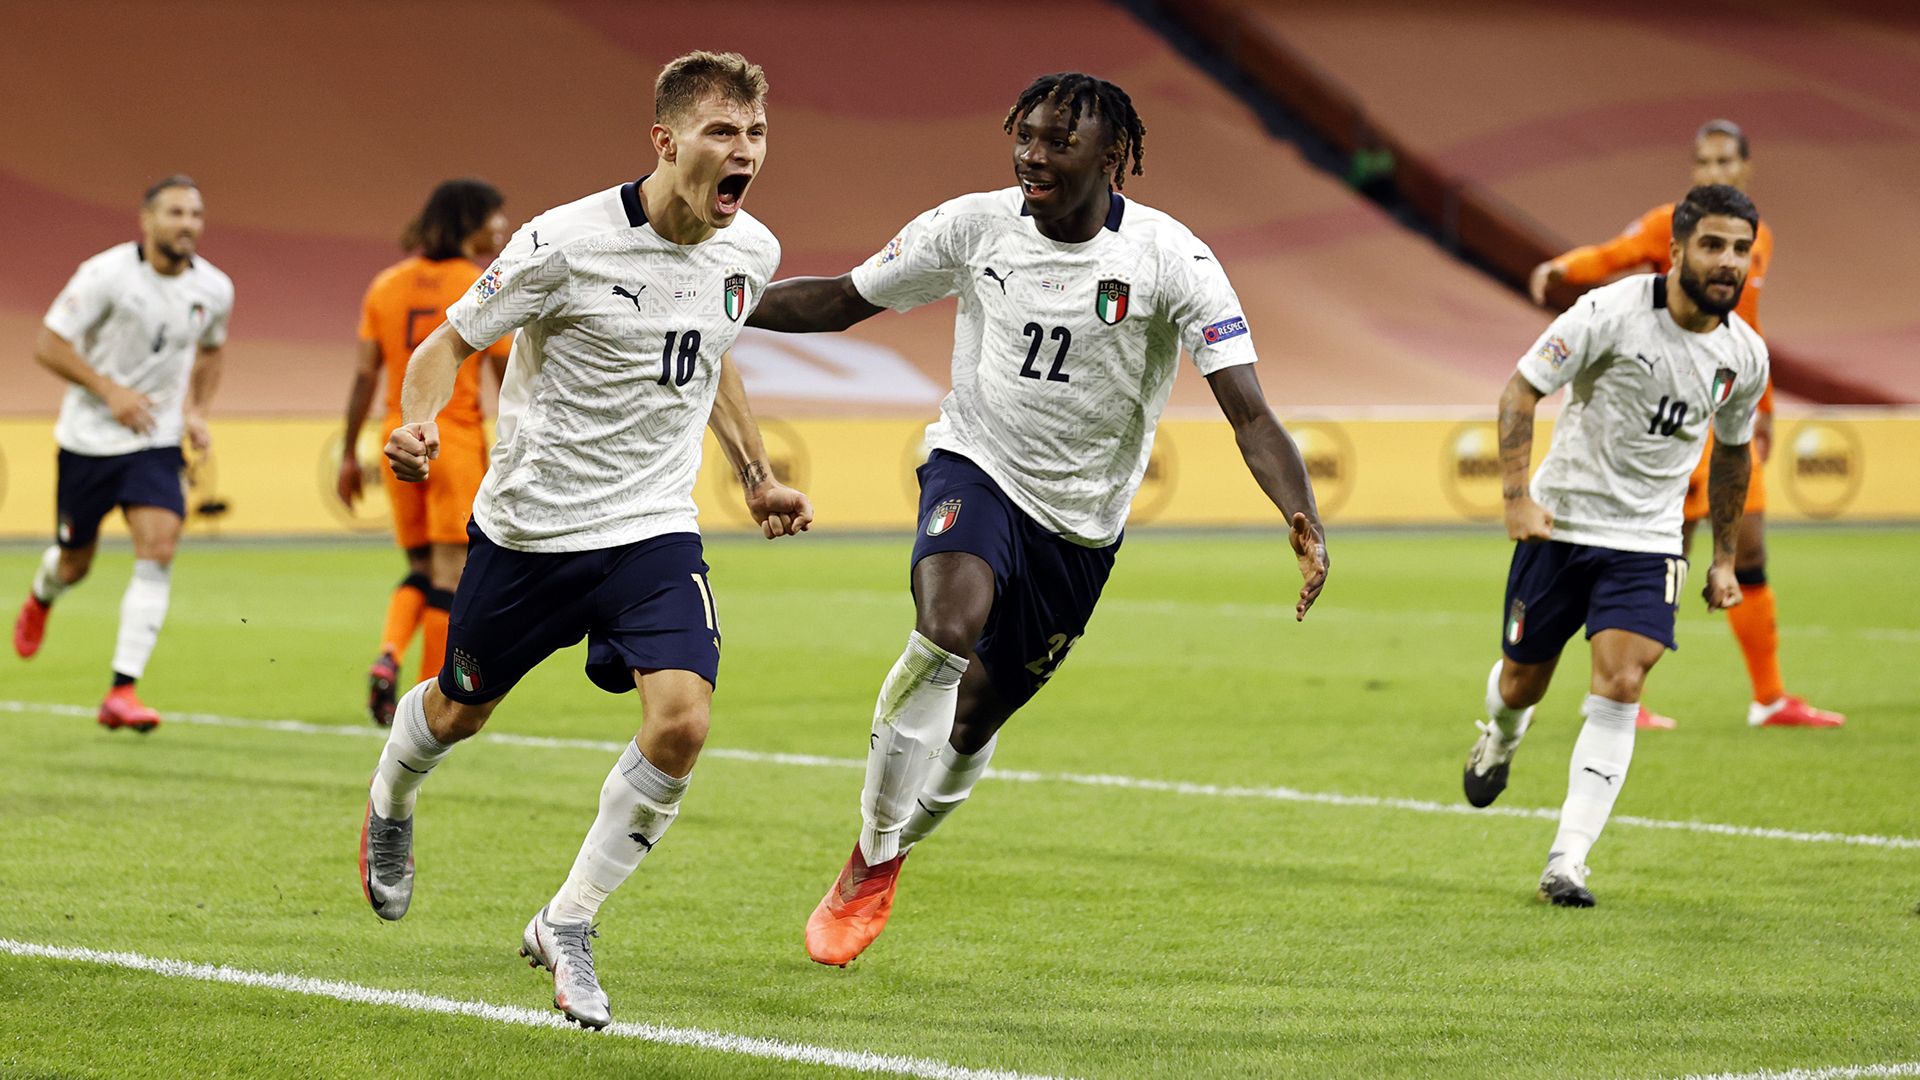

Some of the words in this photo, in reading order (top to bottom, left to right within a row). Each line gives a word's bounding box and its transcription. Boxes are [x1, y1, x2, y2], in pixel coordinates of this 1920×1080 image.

[1100, 282, 1128, 293] ITALIA
[657, 329, 701, 387] 18
[1019, 321, 1072, 383] 22
[1648, 395, 1688, 437] 10
[690, 573, 722, 638] 1
